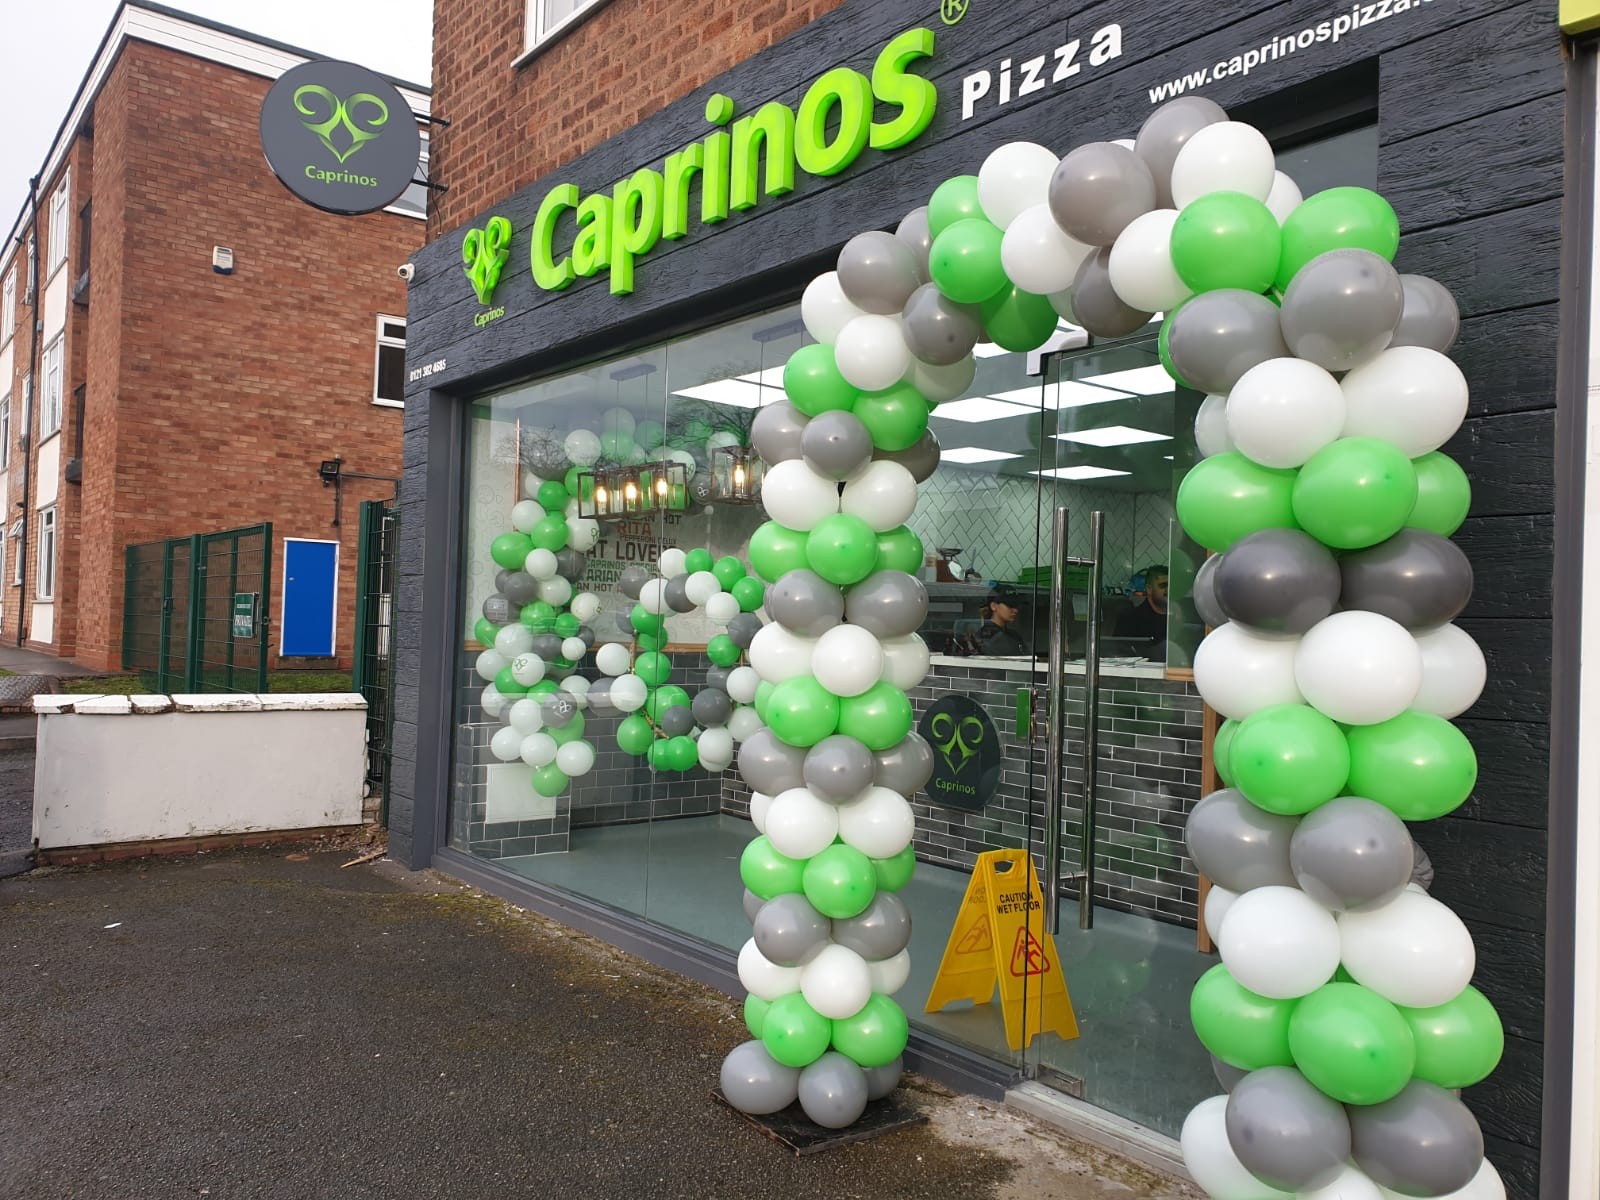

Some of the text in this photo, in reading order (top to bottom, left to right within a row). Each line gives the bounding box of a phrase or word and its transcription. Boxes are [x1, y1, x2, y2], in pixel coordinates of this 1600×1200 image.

[1148, 0, 1433, 103] www.caprinospizza.
[962, 23, 1122, 120] Pizza
[530, 27, 937, 296] Caprinos
[305, 165, 377, 187] Caprinos
[474, 306, 505, 328] Caprinos
[935, 777, 976, 795] Caprinos
[997, 901, 1041, 915] WET FLOOR
[1000, 891, 1034, 904] CAUTION
